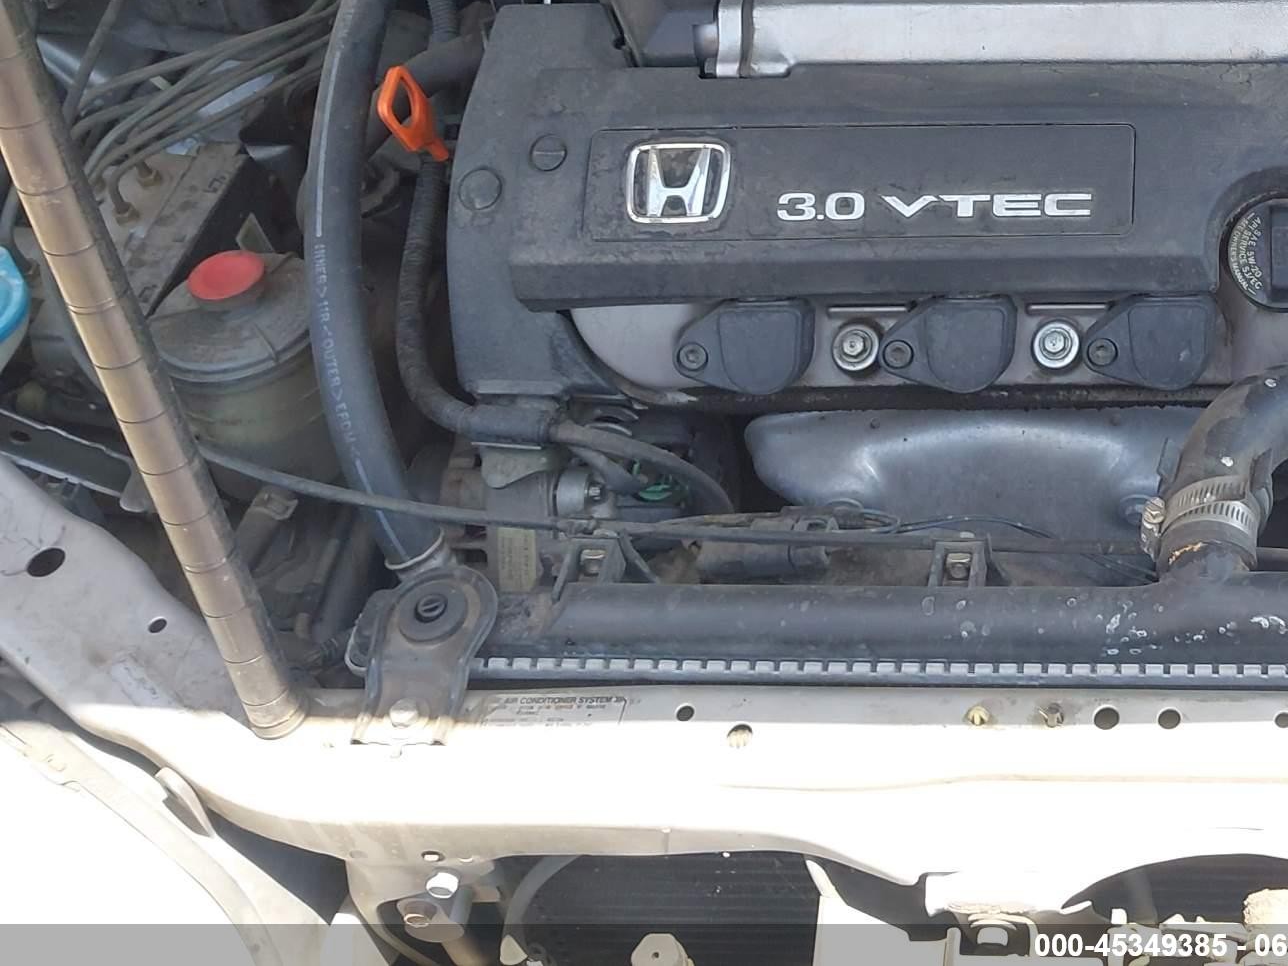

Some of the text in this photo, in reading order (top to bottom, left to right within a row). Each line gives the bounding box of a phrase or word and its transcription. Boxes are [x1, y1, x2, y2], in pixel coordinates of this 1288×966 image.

[776, 191, 1093, 221] 3.0 VTEC
[1249, 216, 1262, 230] API
[1239, 230, 1252, 264] SERVICE
[1248, 229, 1262, 247] SAE
[520, 696, 577, 705] CONDITIONER
[578, 696, 613, 704] SYSTEM
